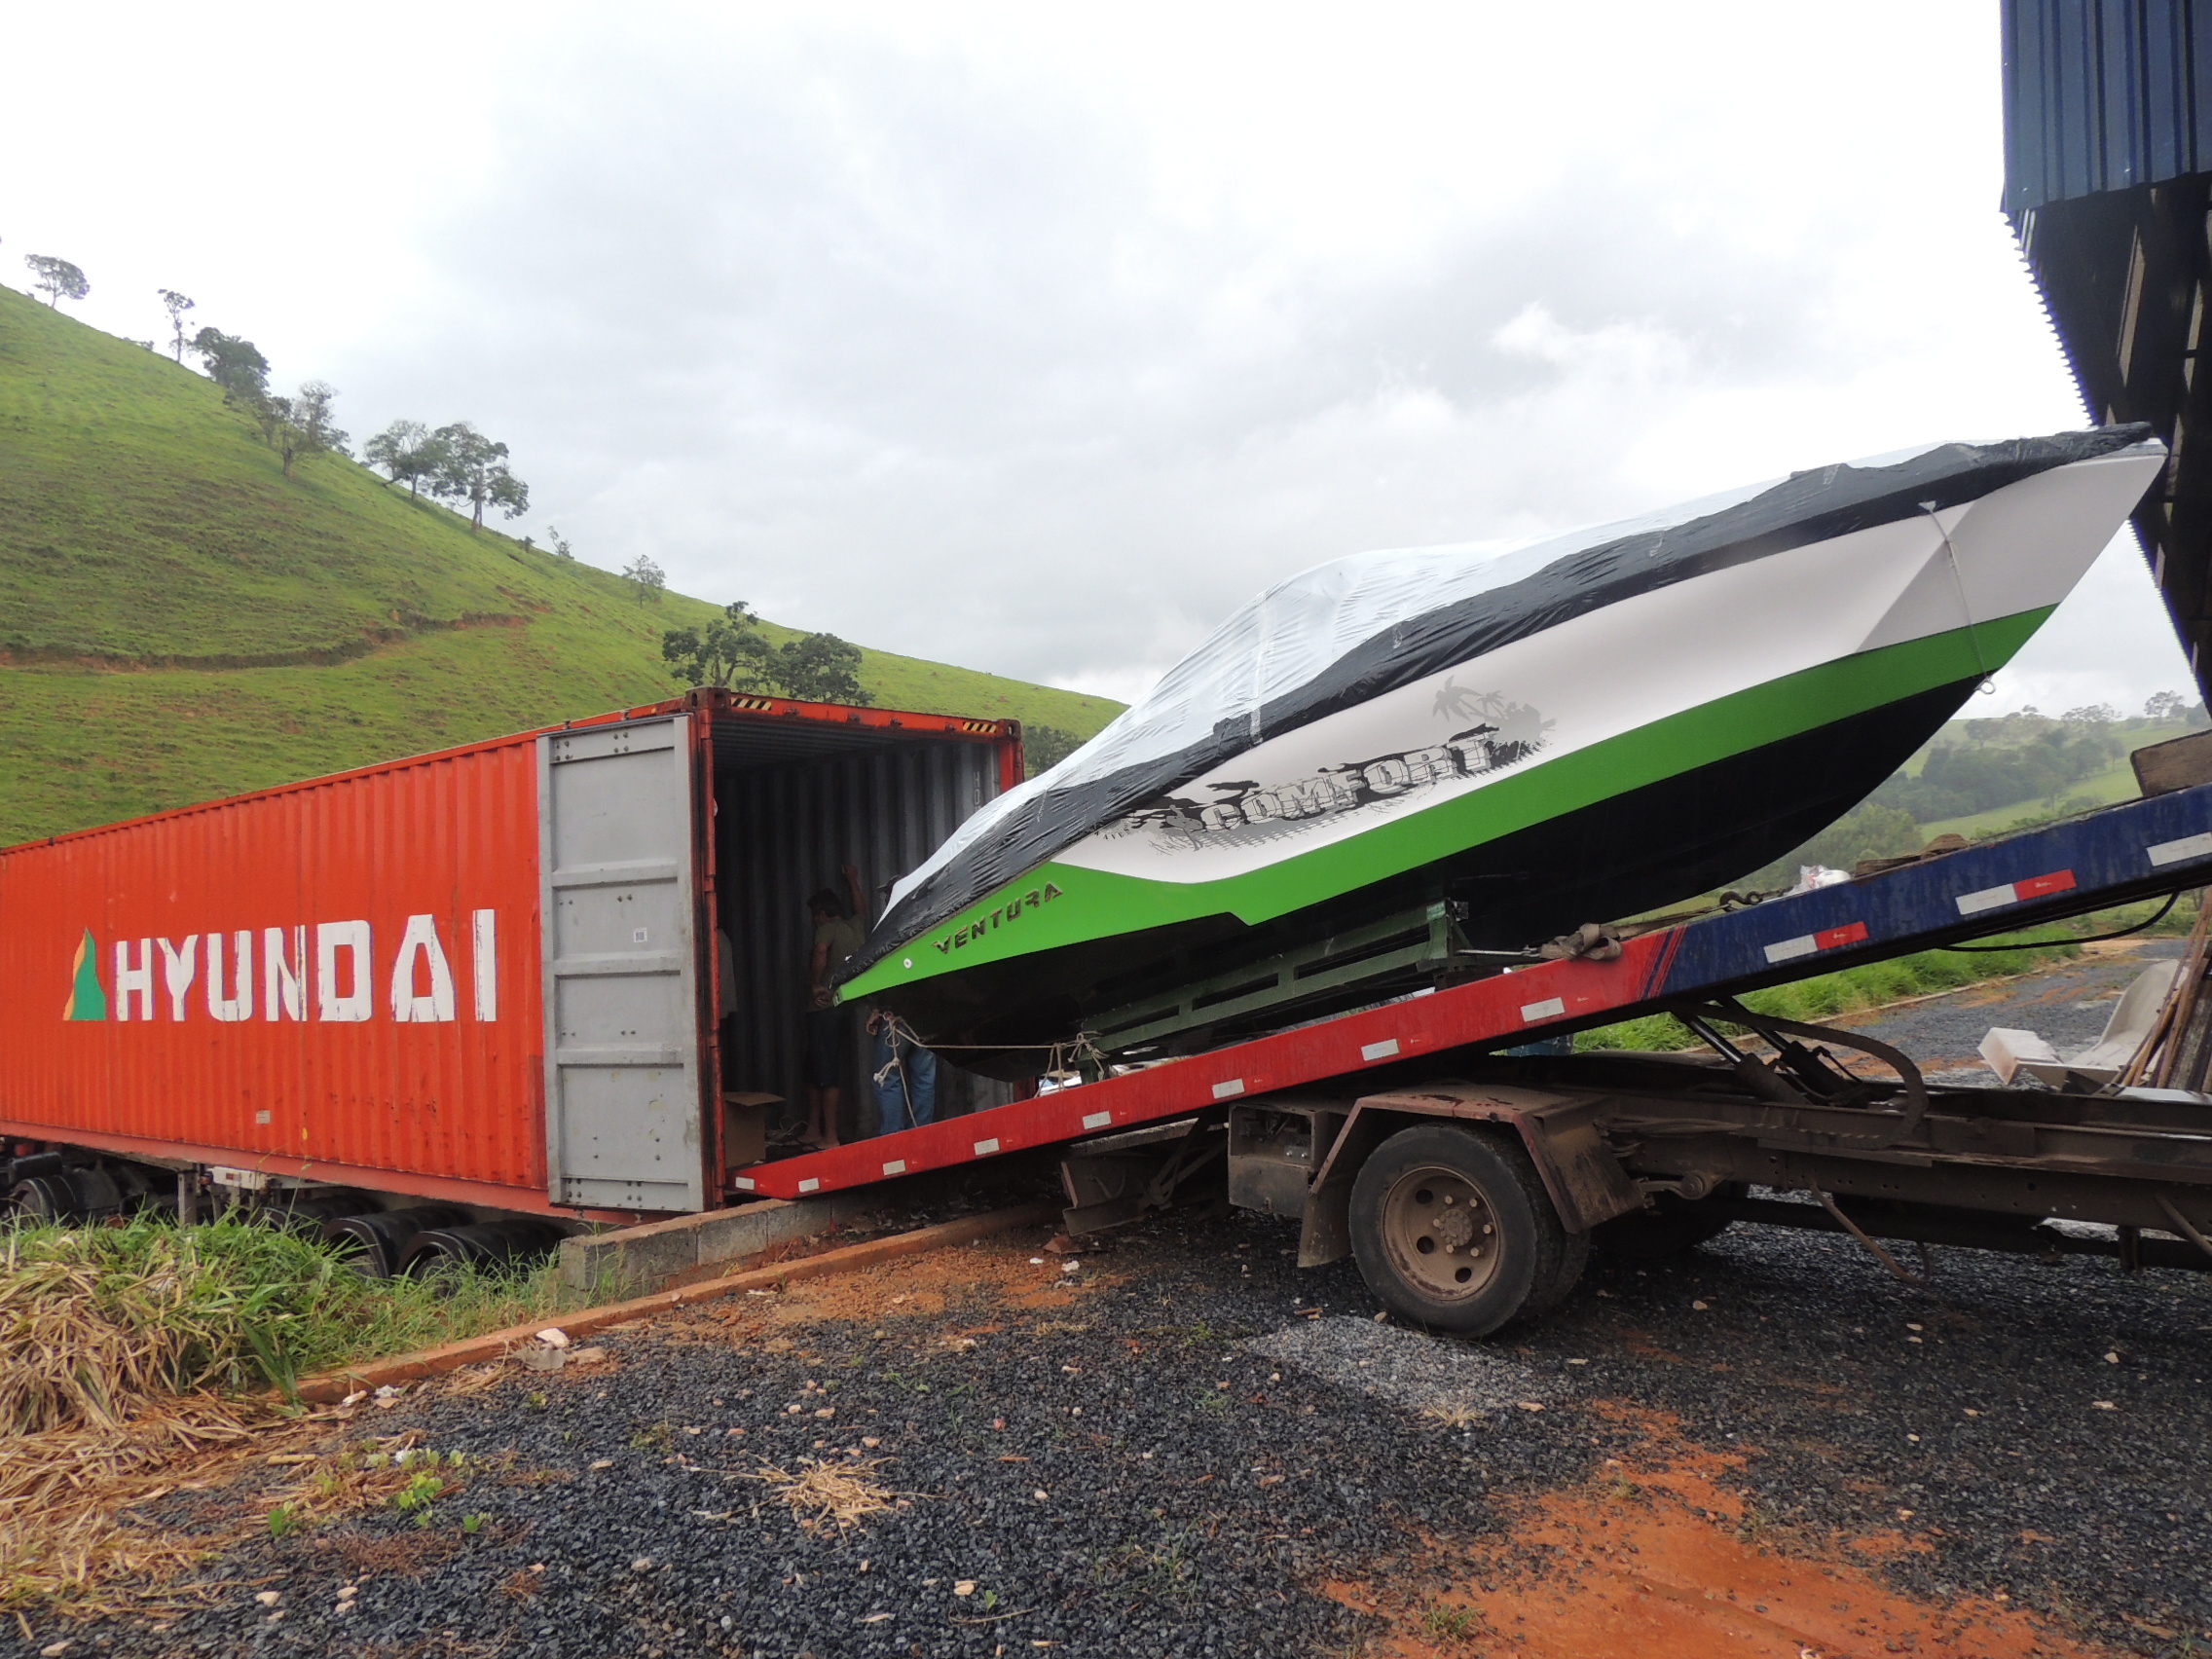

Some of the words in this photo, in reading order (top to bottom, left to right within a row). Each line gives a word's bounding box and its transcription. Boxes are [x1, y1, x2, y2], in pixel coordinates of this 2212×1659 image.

[1200, 730, 1492, 831] COMFORT
[116, 908, 497, 1022] HYUNDAI
[931, 880, 1064, 955] VENTURA
